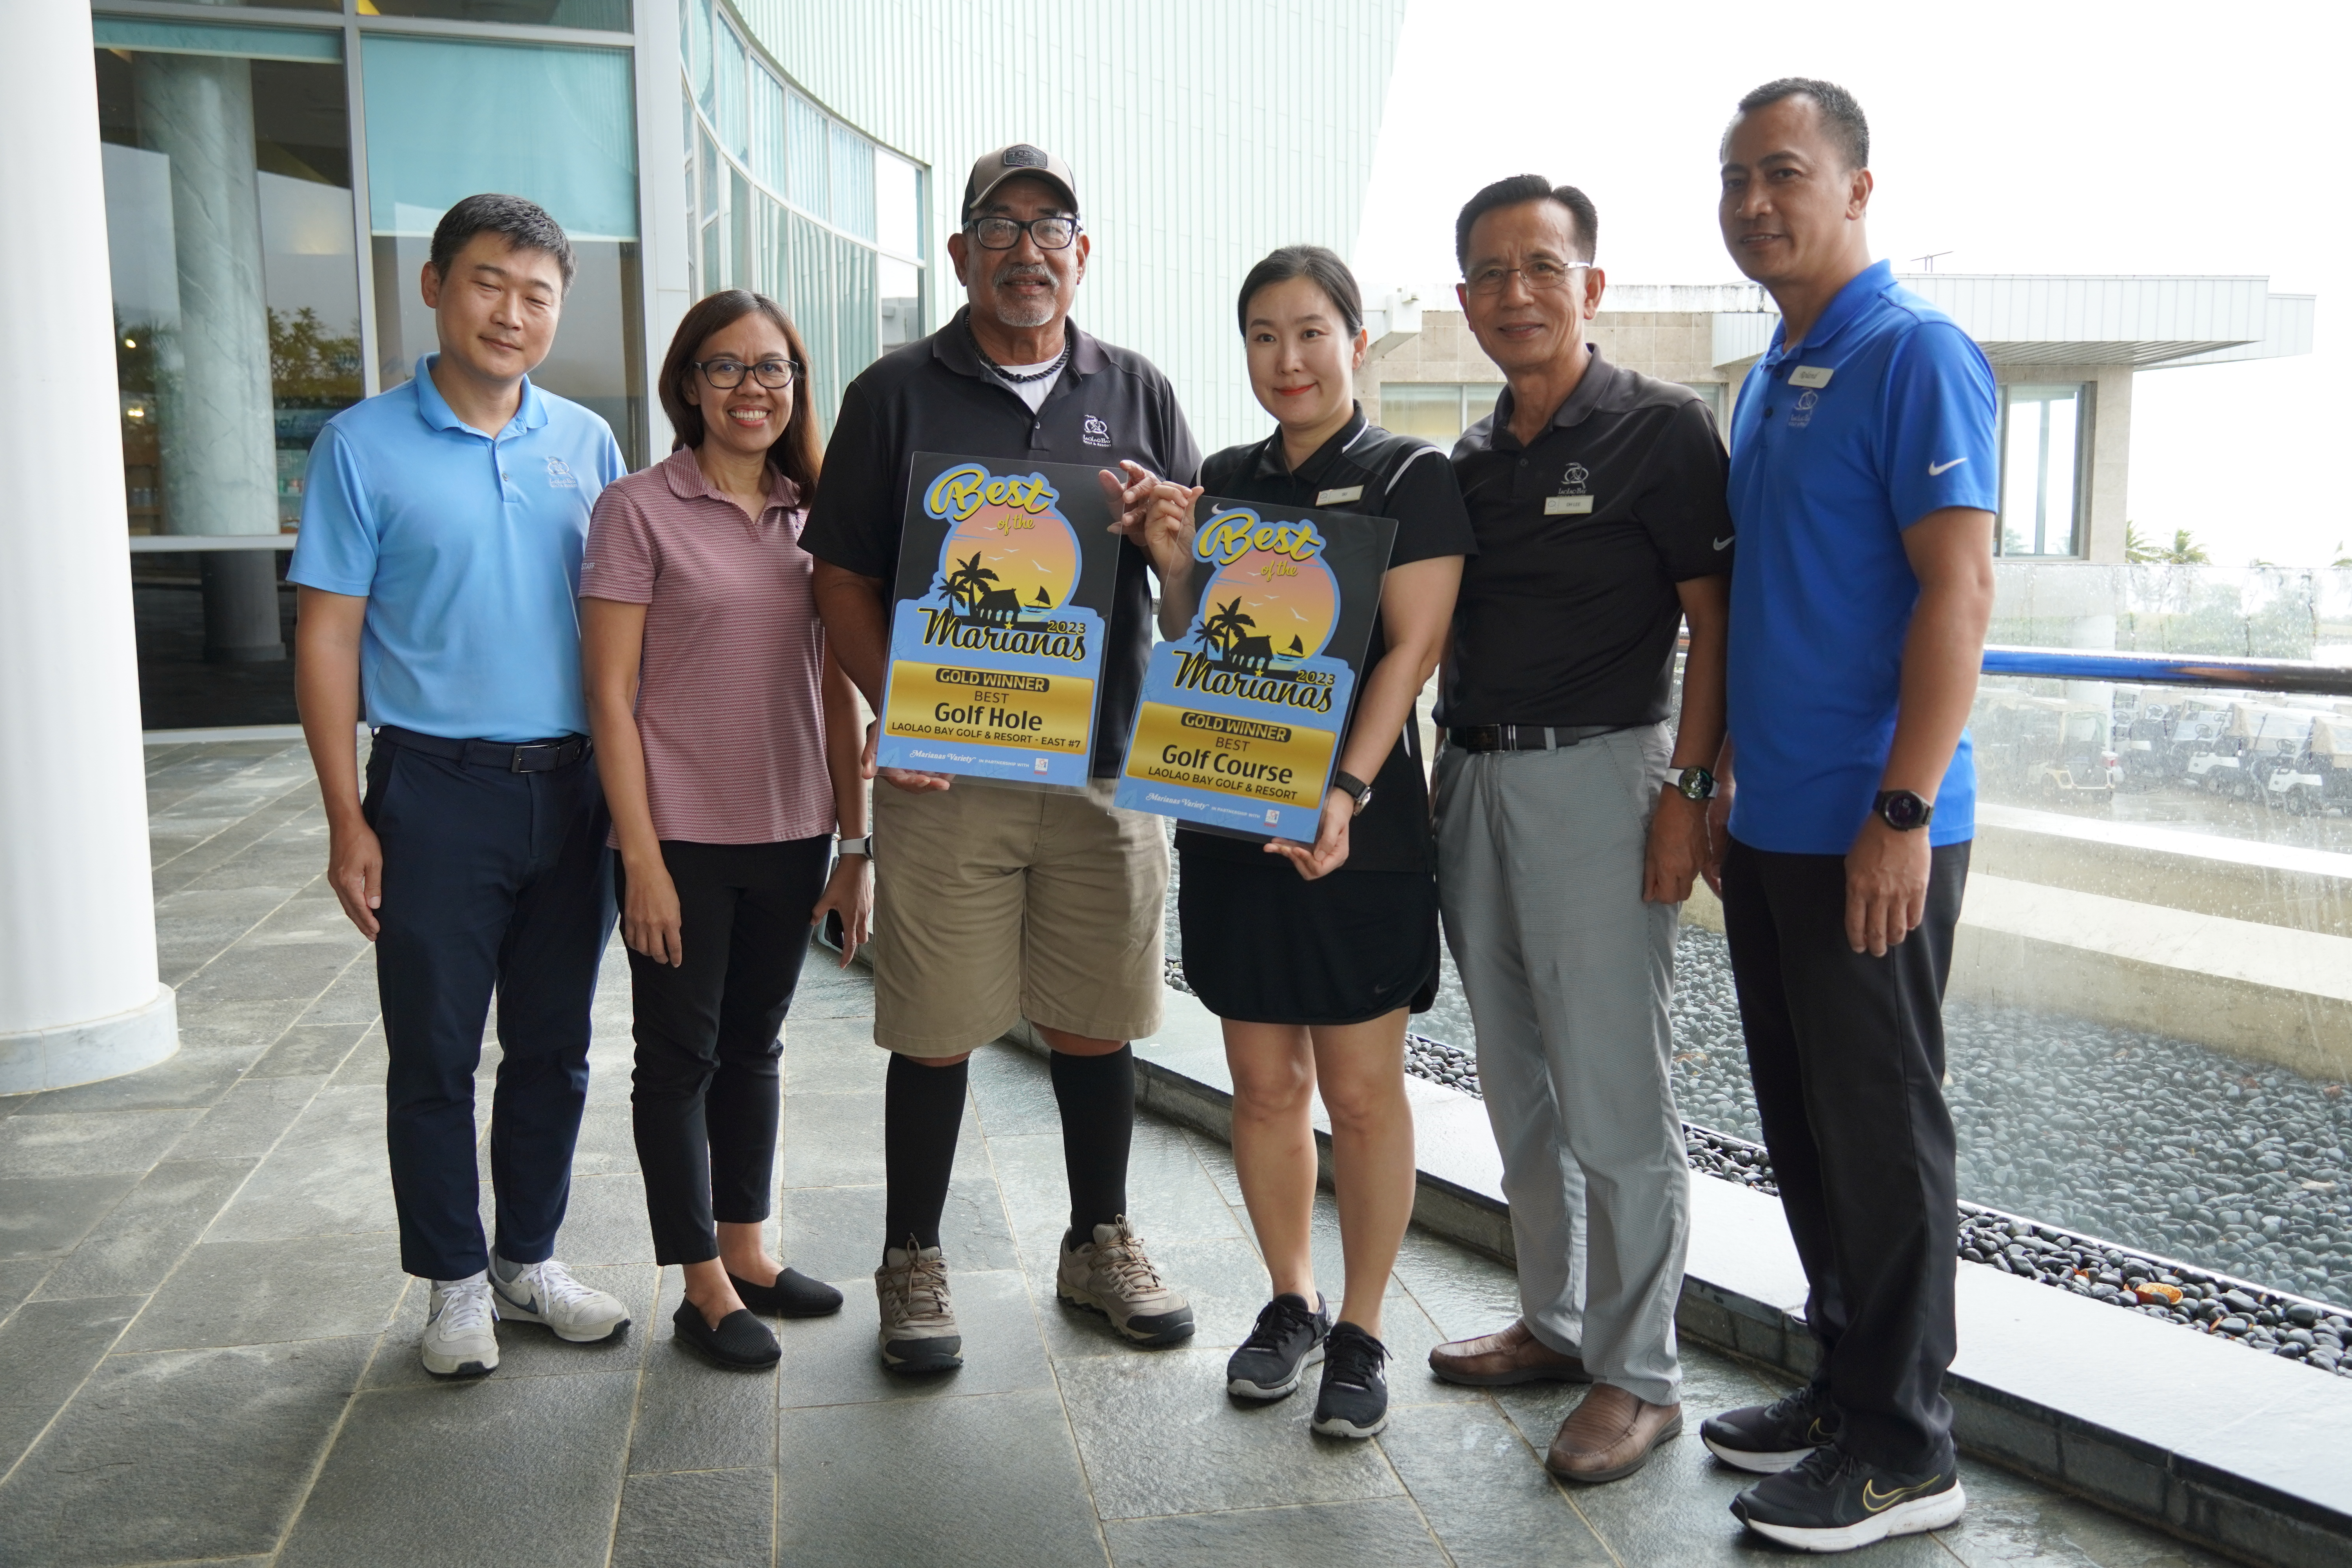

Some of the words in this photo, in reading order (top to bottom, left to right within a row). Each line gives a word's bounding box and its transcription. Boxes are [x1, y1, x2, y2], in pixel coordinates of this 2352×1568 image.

[931, 469, 1053, 522] Best
[997, 514, 1011, 535] of
[1013, 513, 1035, 529] the
[1198, 514, 1320, 566] Best
[1261, 561, 1275, 582] of
[1277, 561, 1298, 576] the
[917, 607, 1086, 662] Marianas
[1047, 620, 1086, 635] 2023
[940, 669, 980, 685] GOLD
[983, 673, 1045, 691] WINNER
[1172, 650, 1333, 713] Marianas
[1296, 669, 1336, 686] 2023
[974, 691, 1009, 704] BEST
[935, 702, 985, 725] Golf
[989, 707, 1043, 731] Hole
[1185, 713, 1224, 731] GOLD
[1226, 720, 1287, 741] WINNER
[892, 722, 932, 733] LAOLAO
[934, 726, 954, 735] BAY
[956, 728, 982, 738] GOLF
[994, 732, 1033, 743] RESORT
[1041, 737, 1066, 746] EAST
[1068, 740, 1081, 748] #7
[1216, 737, 1250, 752] BEST
[909, 750, 946, 759] Marianas
[947, 753, 976, 763] Variety
[1162, 744, 1211, 769] Golf
[1214, 753, 1293, 784] Course
[1149, 766, 1190, 781] LAOLAO
[1192, 774, 1214, 785] BAY
[1216, 778, 1244, 790] GOLF
[1245, 784, 1252, 792] &
[1255, 785, 1298, 800] RESORT
[1145, 793, 1180, 804] Marianas
[1181, 798, 1210, 810] Variety
[1217, 807, 1248, 816] PARTNERSHIP
